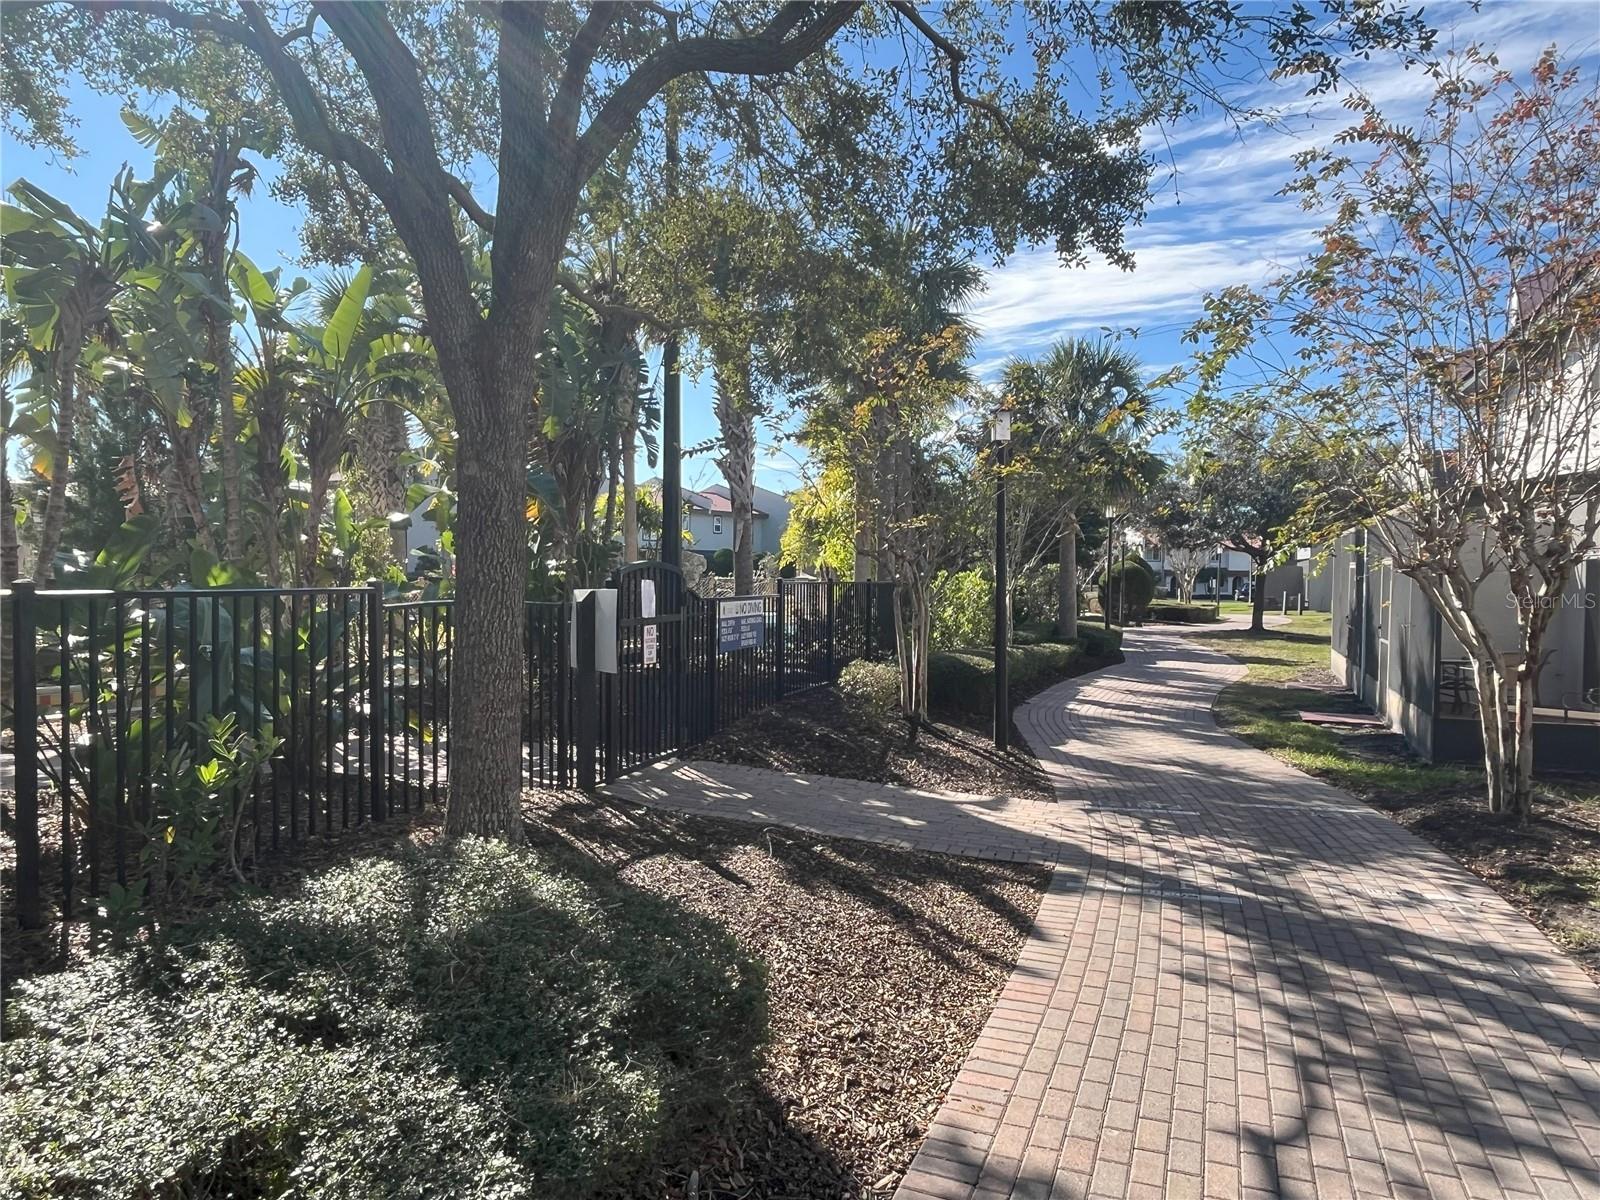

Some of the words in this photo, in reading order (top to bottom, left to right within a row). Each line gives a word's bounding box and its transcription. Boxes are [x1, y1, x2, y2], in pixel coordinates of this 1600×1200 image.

[740, 602, 747, 615] NO
[748, 601, 762, 614] DIVING
[646, 626, 654, 637] NO
